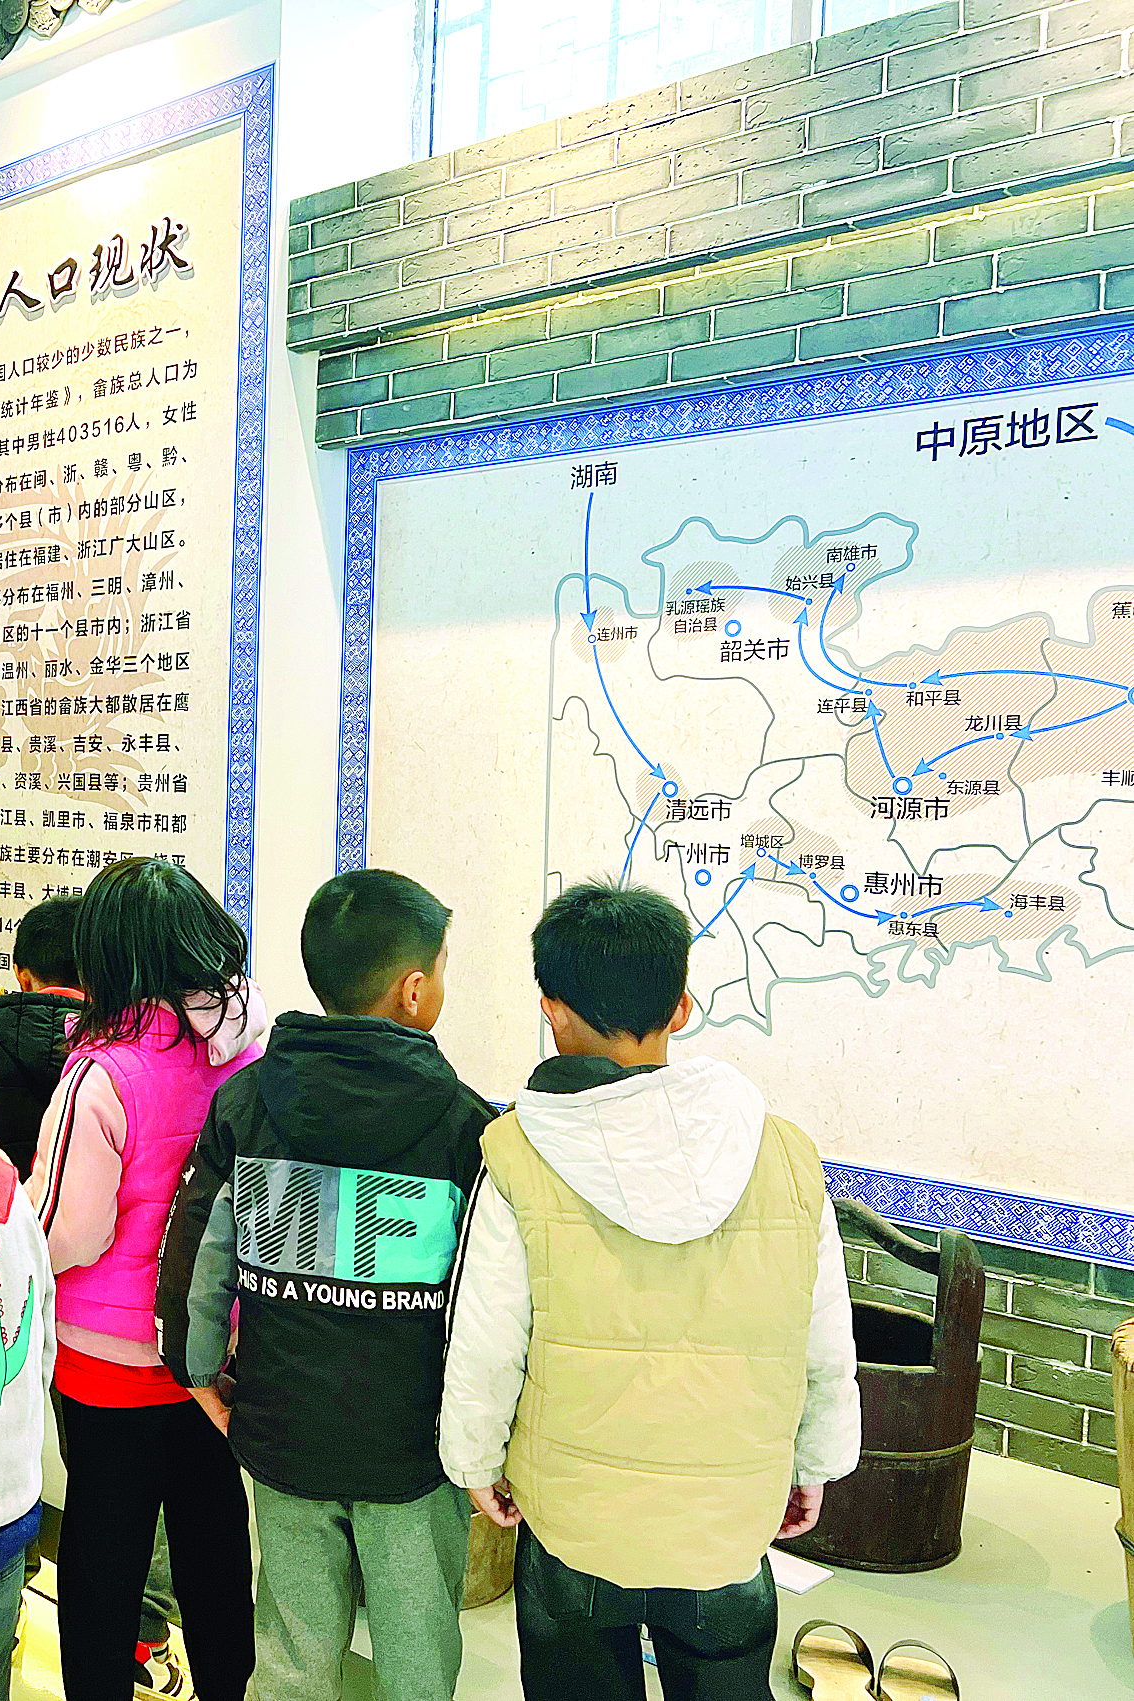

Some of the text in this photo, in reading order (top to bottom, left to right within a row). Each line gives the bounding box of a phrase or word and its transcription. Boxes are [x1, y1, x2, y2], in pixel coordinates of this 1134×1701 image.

[915, 401, 1099, 462] 中原地区
[570, 460, 619, 490] 湖南
[826, 543, 878, 564] 南雄市
[785, 572, 835, 591] 始兴县
[665, 598, 726, 616] 乳源瑶族
[596, 625, 638, 642] 连州市
[673, 617, 718, 634] 自治县
[720, 637, 790, 663] 韶关市
[817, 696, 869, 714] 连平县
[906, 689, 962, 707] 和平县
[965, 714, 1023, 733] 龙川县
[946, 779, 1001, 796] 东源县
[664, 799, 732, 822] 清远市
[870, 795, 951, 821] 河源市
[739, 833, 785, 850] 增城区
[664, 843, 731, 866] 广州市
[798, 854, 846, 871] 博罗县
[863, 872, 944, 898] 惠州市
[1009, 894, 1067, 912] 海丰县
[888, 921, 940, 938] 惠东县
[261, 1276, 278, 1298] IS
[283, 1282, 299, 1301] A
[302, 1282, 377, 1310] YOUNG
[382, 1290, 445, 1311] BRAND
